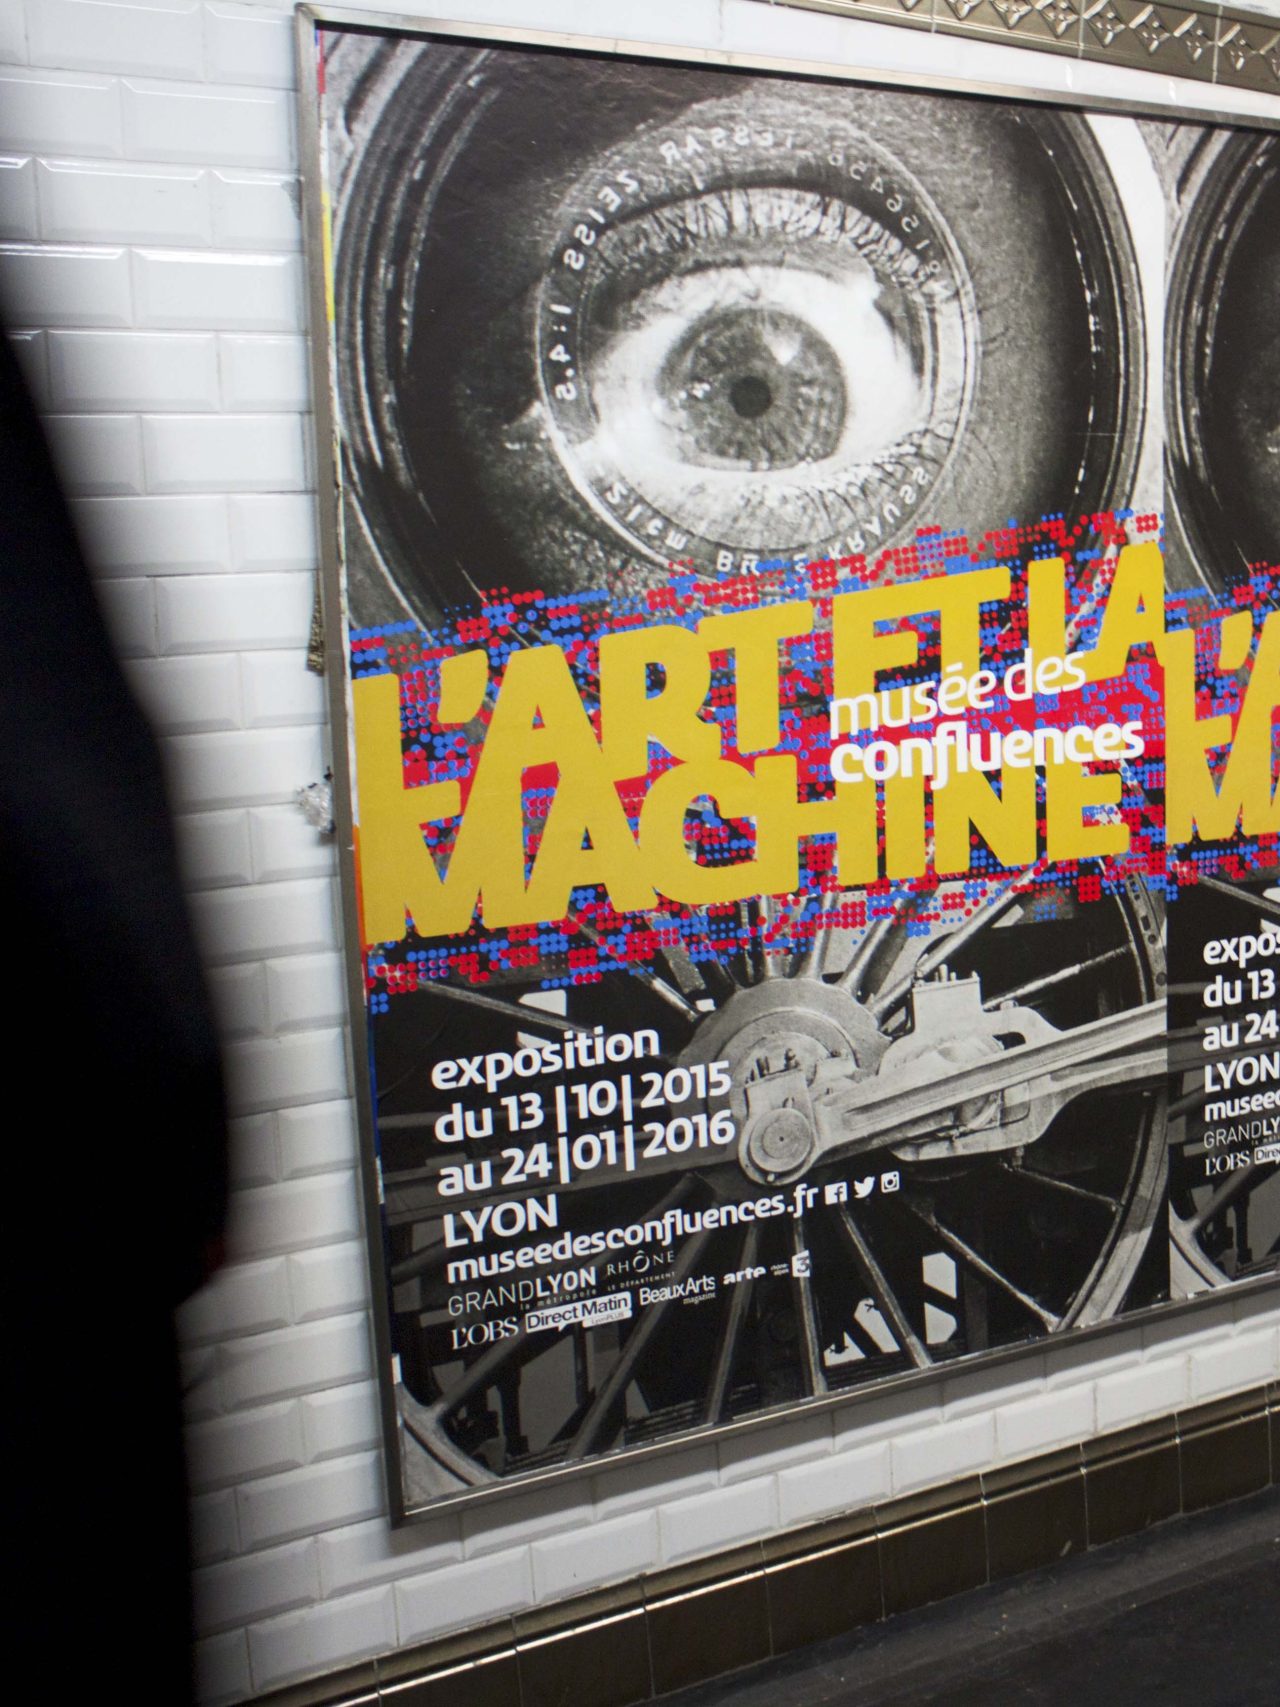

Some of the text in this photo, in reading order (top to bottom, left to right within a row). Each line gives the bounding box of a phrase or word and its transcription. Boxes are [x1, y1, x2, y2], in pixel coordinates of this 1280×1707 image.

[352, 541, 1165, 819] L'ART ET LA
[829, 648, 1086, 740] musée des
[829, 717, 1145, 790] confluences
[360, 755, 1130, 945] MACHINE
[1203, 975, 1242, 1008] du
[431, 1025, 659, 1093] exposition
[1203, 1022, 1239, 1051] au
[1204, 1051, 1280, 1093] LYON
[434, 1103, 493, 1142] du
[437, 1160, 492, 1196] au
[1205, 1151, 1250, 1176] L'OBS
[443, 1194, 558, 1248] LYON
[447, 1183, 818, 1284] museedesconfluences.fr
[606, 1249, 675, 1276] RHÔNE
[452, 1317, 519, 1350] L'OBS
[527, 1307, 578, 1330] Direct
[582, 1295, 629, 1318] Matin
[723, 1266, 766, 1285] arte
